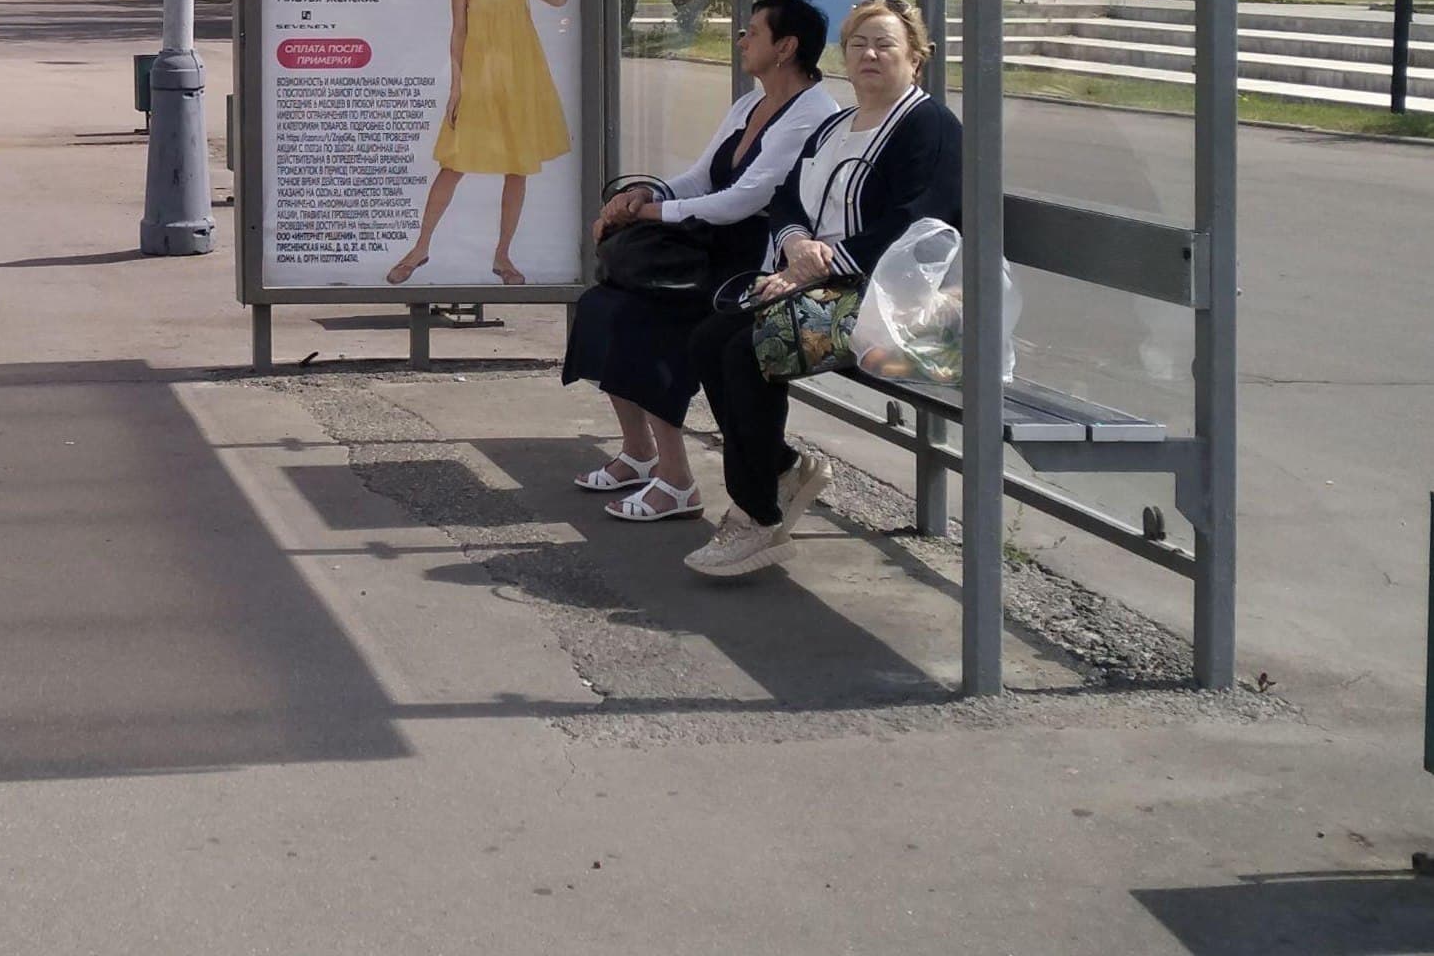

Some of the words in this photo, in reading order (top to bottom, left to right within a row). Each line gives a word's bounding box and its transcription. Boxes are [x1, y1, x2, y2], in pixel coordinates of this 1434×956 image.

[285, 45, 326, 53] ОПЛАТА
[328, 45, 364, 53] ПОСЛЕ
[297, 56, 352, 65] ПРИМЕРКИ
